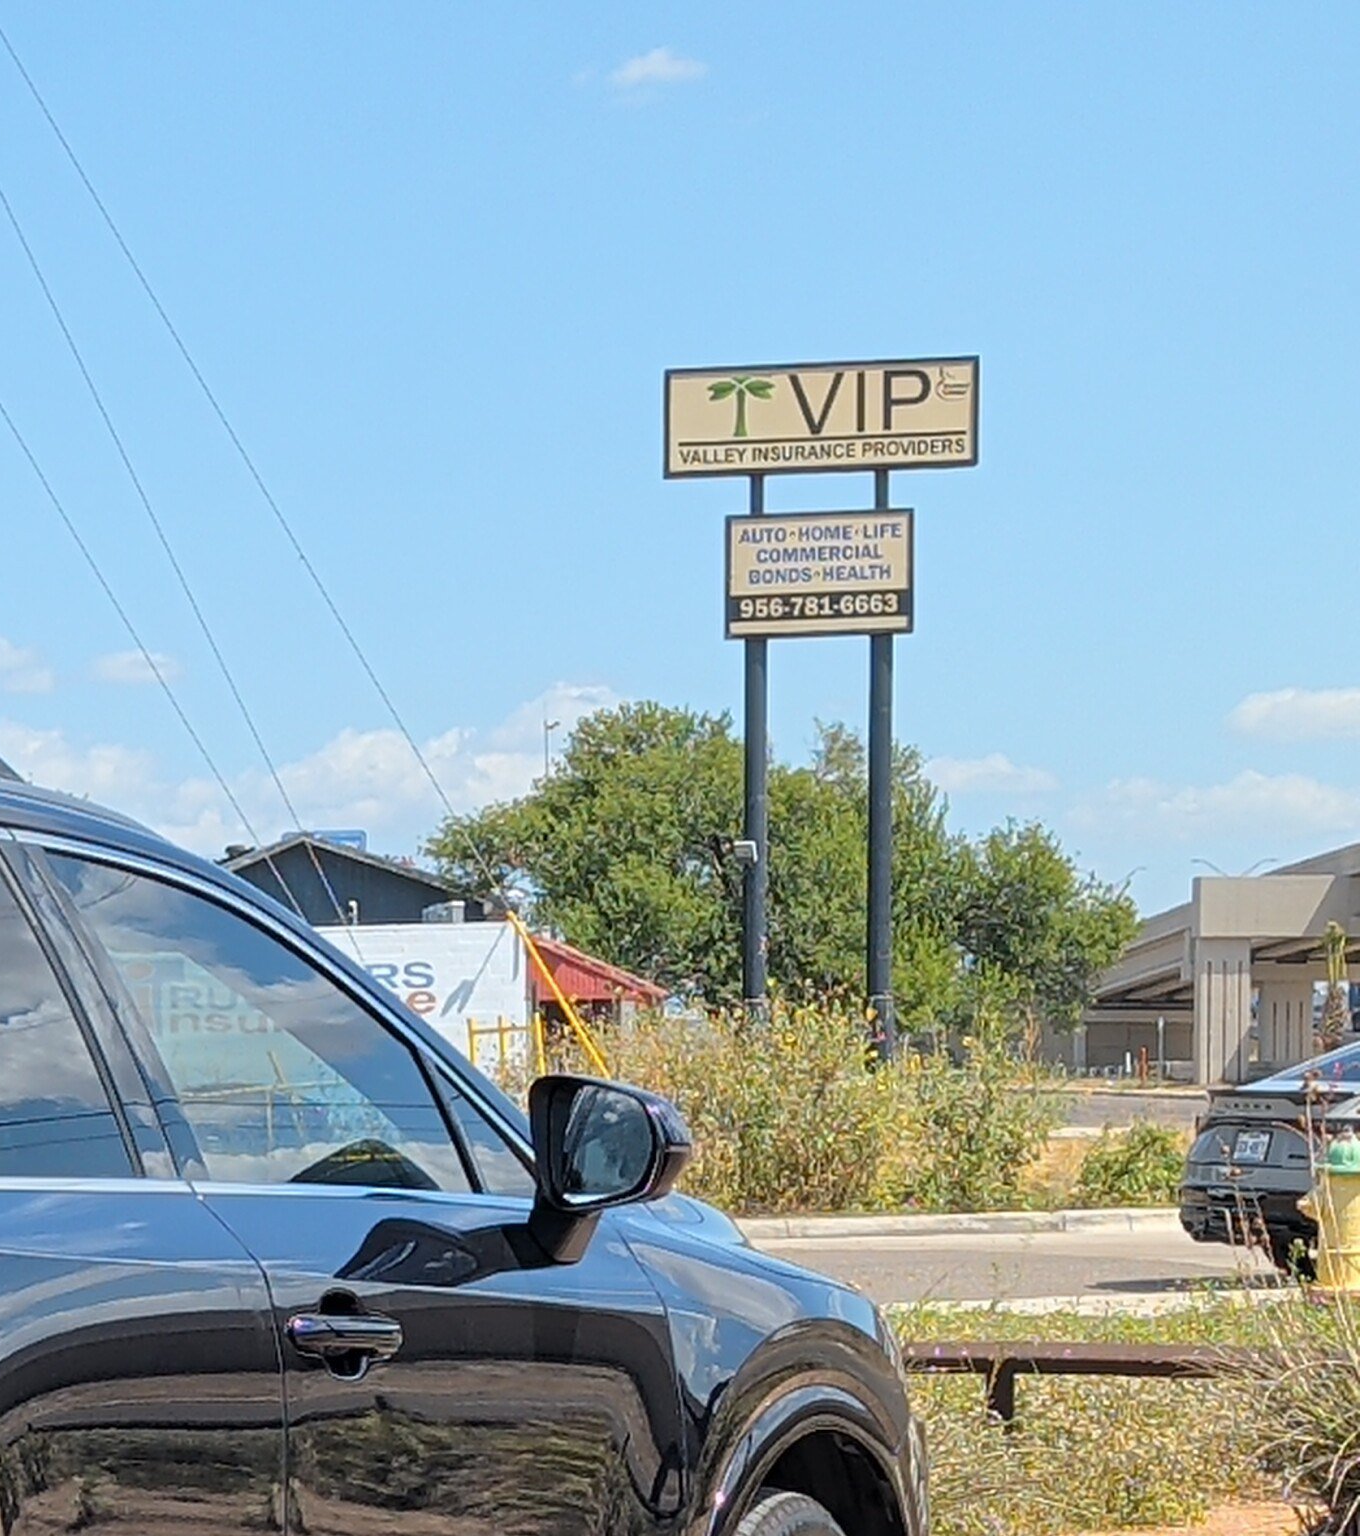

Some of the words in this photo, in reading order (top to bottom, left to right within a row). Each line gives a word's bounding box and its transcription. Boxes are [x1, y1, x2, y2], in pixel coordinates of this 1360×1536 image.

[787, 370, 932, 436] VIP
[678, 448, 747, 465] VALLEY
[752, 442, 856, 463] INSURANCE
[861, 437, 966, 458] PROVIDERS
[756, 544, 884, 564] COMMERCIAL
